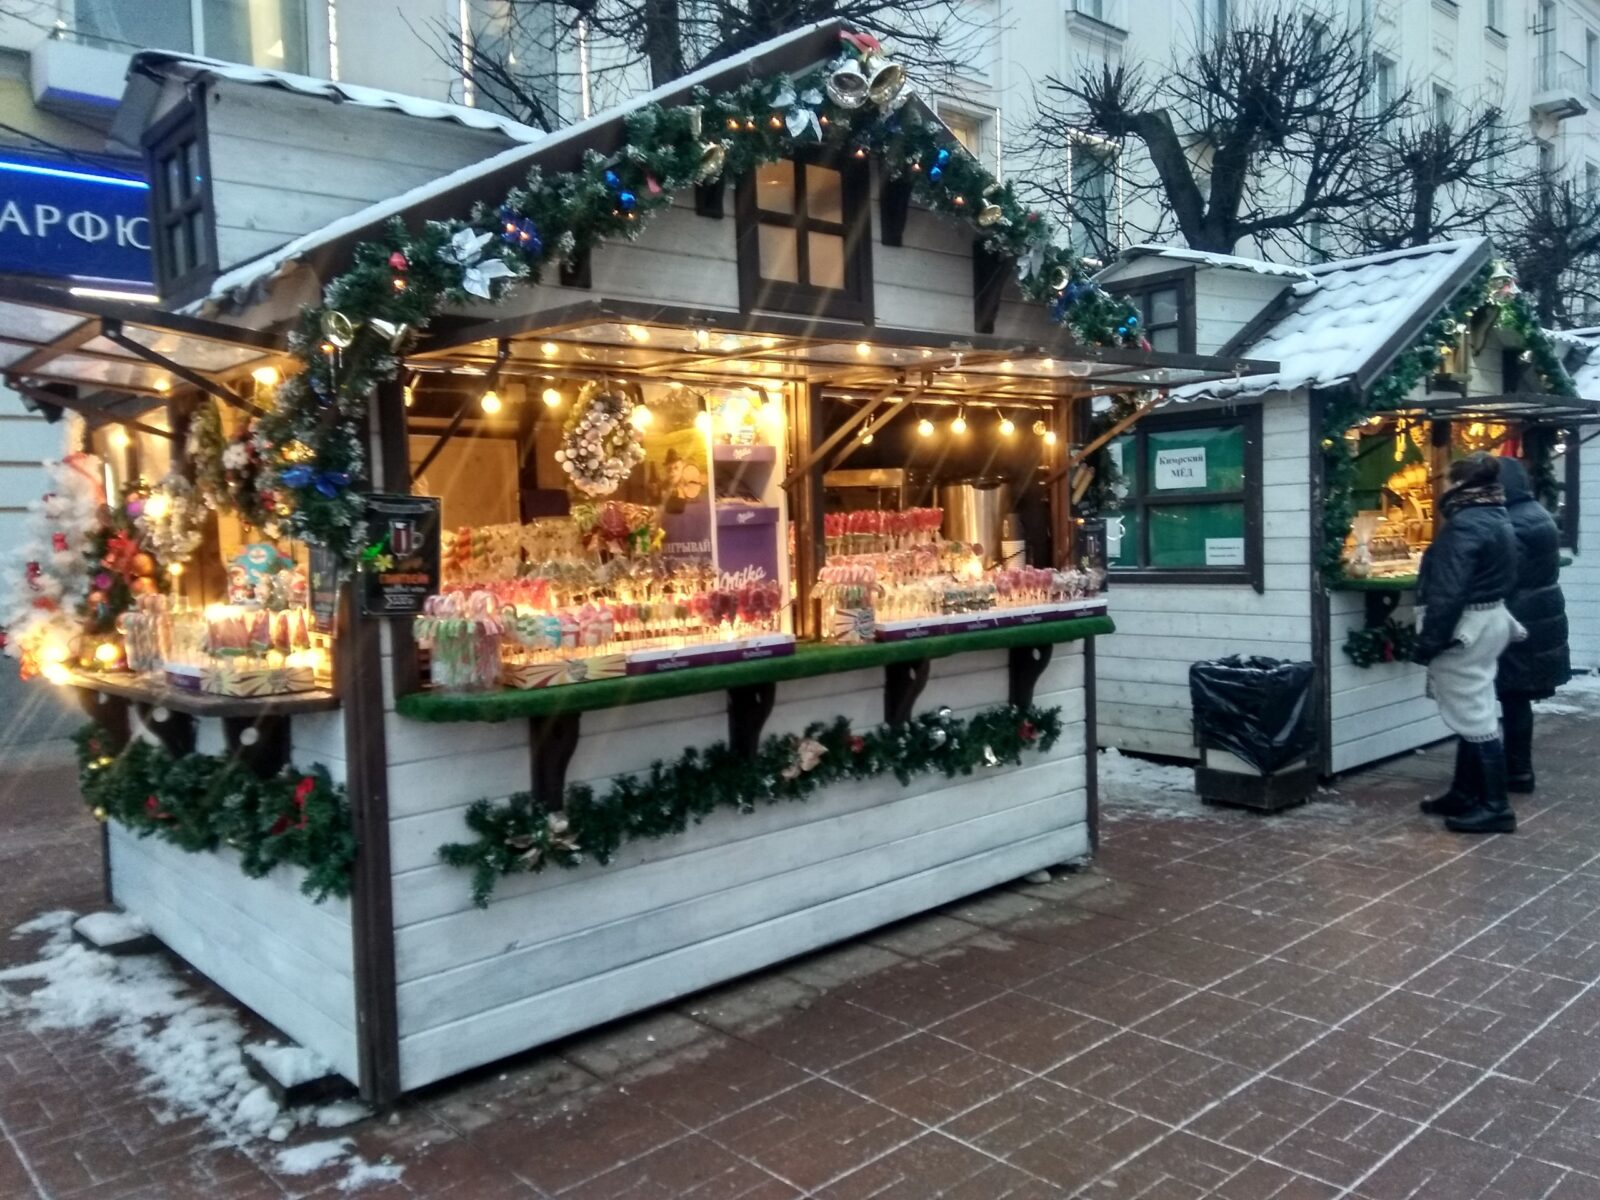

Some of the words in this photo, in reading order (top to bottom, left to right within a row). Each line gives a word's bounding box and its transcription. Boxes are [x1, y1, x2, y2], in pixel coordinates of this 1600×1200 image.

[1159, 454, 1203, 465] Кимрский
[1171, 468, 1193, 478] МЁД
[719, 564, 767, 593] Milka
